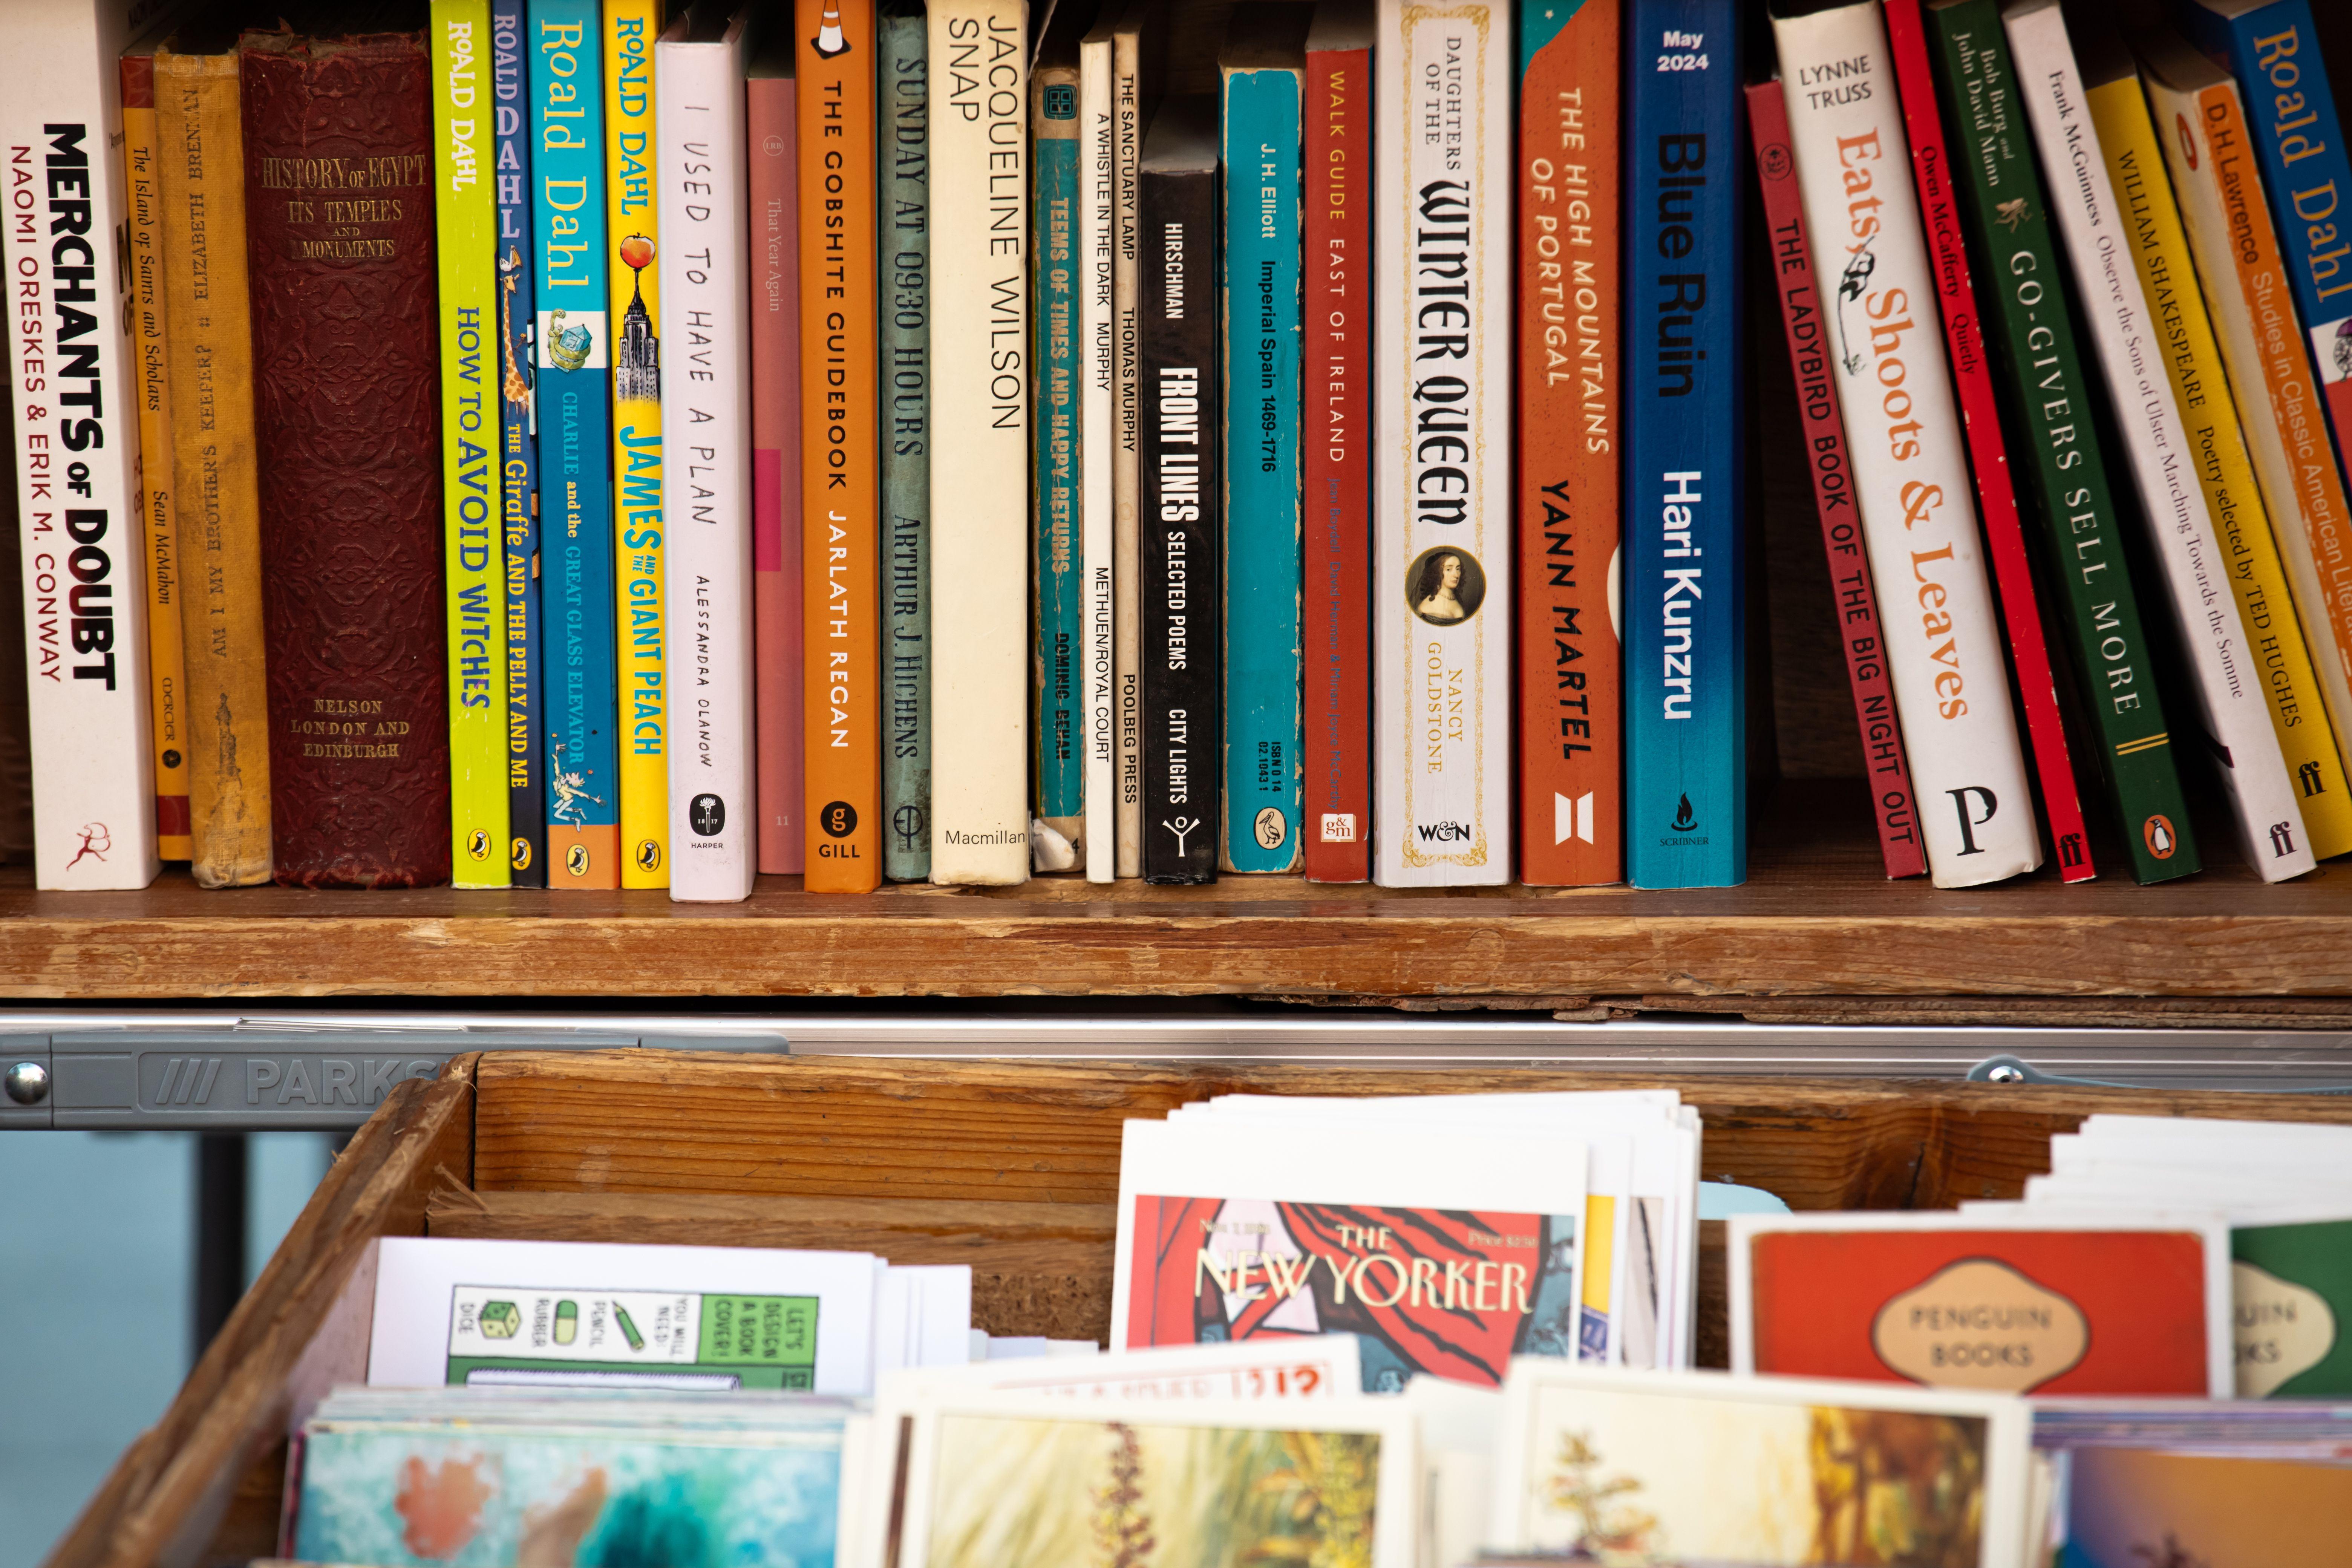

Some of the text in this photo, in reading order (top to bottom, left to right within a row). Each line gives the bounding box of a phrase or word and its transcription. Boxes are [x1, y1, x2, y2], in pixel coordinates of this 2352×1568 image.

[949, 18, 979, 121] SNAP
[1426, 63, 1440, 144] OF THE
[1447, 38, 1461, 170] DAUGHTERS
[1658, 54, 1709, 71] 2024
[1664, 31, 1703, 49] May
[1800, 54, 1872, 86] LYNNE
[1807, 81, 1872, 109] TRUSS
[449, 21, 476, 191] ROALD DAHL
[542, 20, 588, 289] Roald Dahl
[617, 17, 648, 215] ROALD DAHL
[1122, 74, 1134, 260] THE SANCTUARY LAMP
[262, 155, 426, 188] HISTORY OF EGYPT
[287, 200, 401, 222] ITS TEMPLES
[335, 227, 360, 236] AND
[683, 143, 710, 221] USED
[988, 15, 1020, 428] JACQUELINE WILSON
[1098, 114, 1110, 305] A WHISTLE IN THE DARK
[1261, 144, 1276, 238] J. H. Elliott
[303, 240, 394, 257] MONUMENTS
[685, 248, 710, 284] TO
[824, 81, 845, 490] THE GOBSHITE GUIDEBOOK
[1165, 224, 1183, 318] HIRSCHMAN
[1330, 72, 1344, 461] WALK GUIDE EAST OF IRELAND
[1532, 158, 1569, 385] OF PORTUGAL
[1560, 88, 1609, 455] THE HIGH MOUNTAINS
[1658, 133, 1707, 398] Blue Ruin
[43, 124, 115, 691] MERCHANTS OF DOUBT
[687, 311, 713, 381] HAVE
[1097, 323, 1109, 390] MURPHY
[1258, 262, 1276, 472] Imperial Spain 1469-1716
[11, 147, 60, 682] NAOMI ORESKES & ERIK M. CONWAY
[689, 408, 714, 422] A
[1160, 368, 1199, 522] FRONT LINES
[1837, 127, 1968, 719] Eats, Shoots & Leaves
[2119, 149, 2302, 728] WILLIAM SHAKESPEARE Poetry selected by TED HUGHES
[458, 307, 490, 708] HOW TO AVOID WITCHES
[690, 447, 716, 524] PLAN
[1776, 219, 1913, 844] THE LADYBIRD BOOK OF THE BIG NIGHT OUT
[2011, 250, 2140, 714] GO-GIVERS SELL MORE
[505, 424, 528, 788] THE Giraffe AND THE PELLY AND ME
[563, 392, 584, 764] CHARLIE and the GREAT GLASS ELEVATOR
[619, 426, 663, 754] JAMES AND THE GIANT PEACH
[829, 511, 848, 747] JARLATH REGAN
[1168, 532, 1186, 669] SELECTED POEMS
[1541, 480, 1591, 759] YANN MARTEL
[1663, 472, 1701, 719] Hari Kunzru
[291, 721, 409, 735] LONDON AND
[314, 699, 382, 713] NELSON
[697, 576, 712, 767] ALESSANDRA OLANOW
[1096, 568, 1109, 762] METHUEN/ROYAL COURT
[1428, 643, 1442, 773] GOLDSTONE
[1449, 669, 1462, 741] NANCY
[303, 744, 399, 758] EDINBURGH
[1124, 675, 1136, 803] POOLBEG PRESS
[1169, 709, 1187, 803] CITY LIGHTS
[819, 844, 860, 858] GILL
[946, 831, 1025, 844] Macmillan
[1418, 822, 1469, 841] W&N
[1660, 838, 1709, 846] SCRIBNER
[1194, 1248, 1535, 1314] NEW YORKER
[1335, 1223, 1392, 1250] THE
[1910, 1306, 2050, 1331] PENGUIN
[1932, 1343, 2034, 1368] BOOKS
